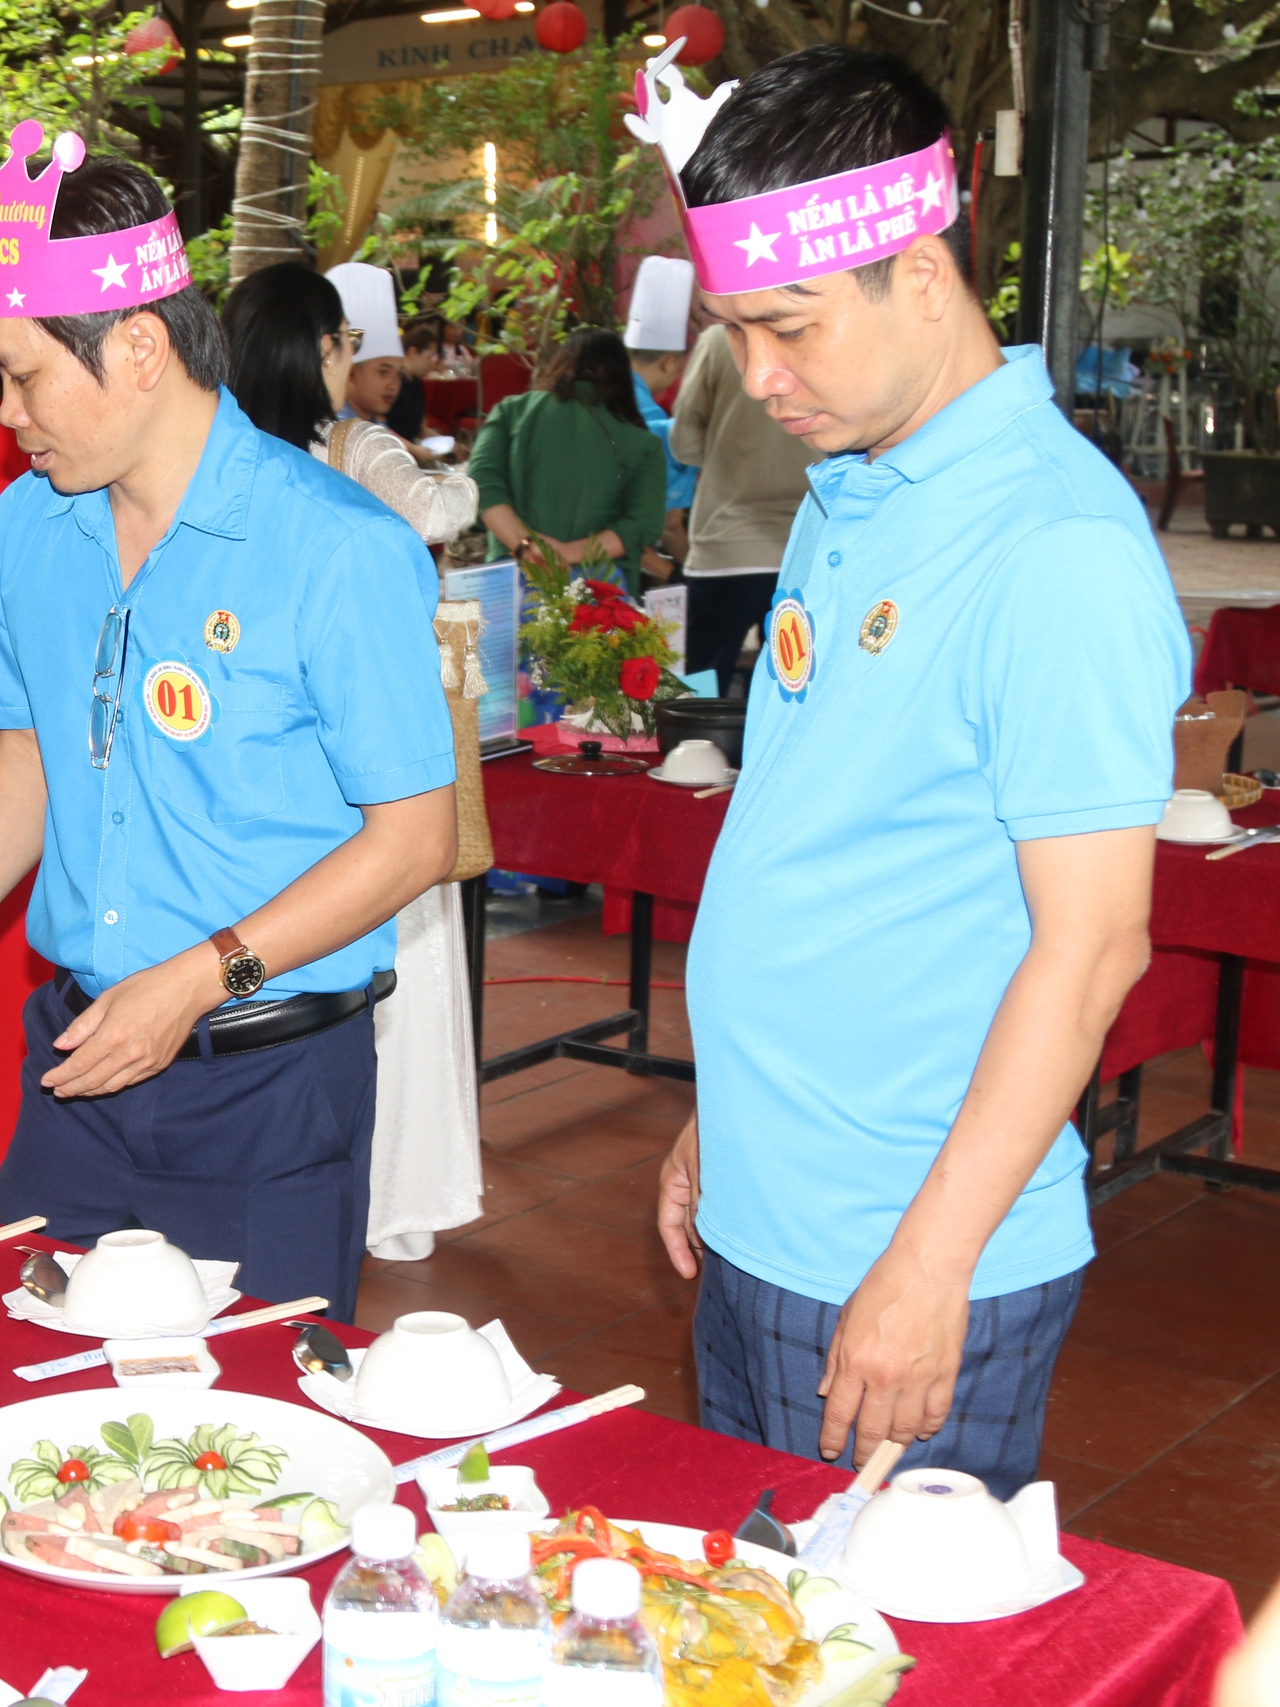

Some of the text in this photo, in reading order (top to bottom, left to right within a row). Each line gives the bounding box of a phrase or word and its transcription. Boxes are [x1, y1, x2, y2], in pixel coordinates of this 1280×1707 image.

[786, 172, 916, 236] NẾM LÀ MÊ
[135, 231, 167, 266] NẾM
[798, 204, 916, 268] ĂN LÀ PHÊ
[140, 266, 163, 293] ĂN
[164, 255, 181, 284] LÀ
[779, 617, 806, 671] 01
[158, 680, 197, 722] 01
